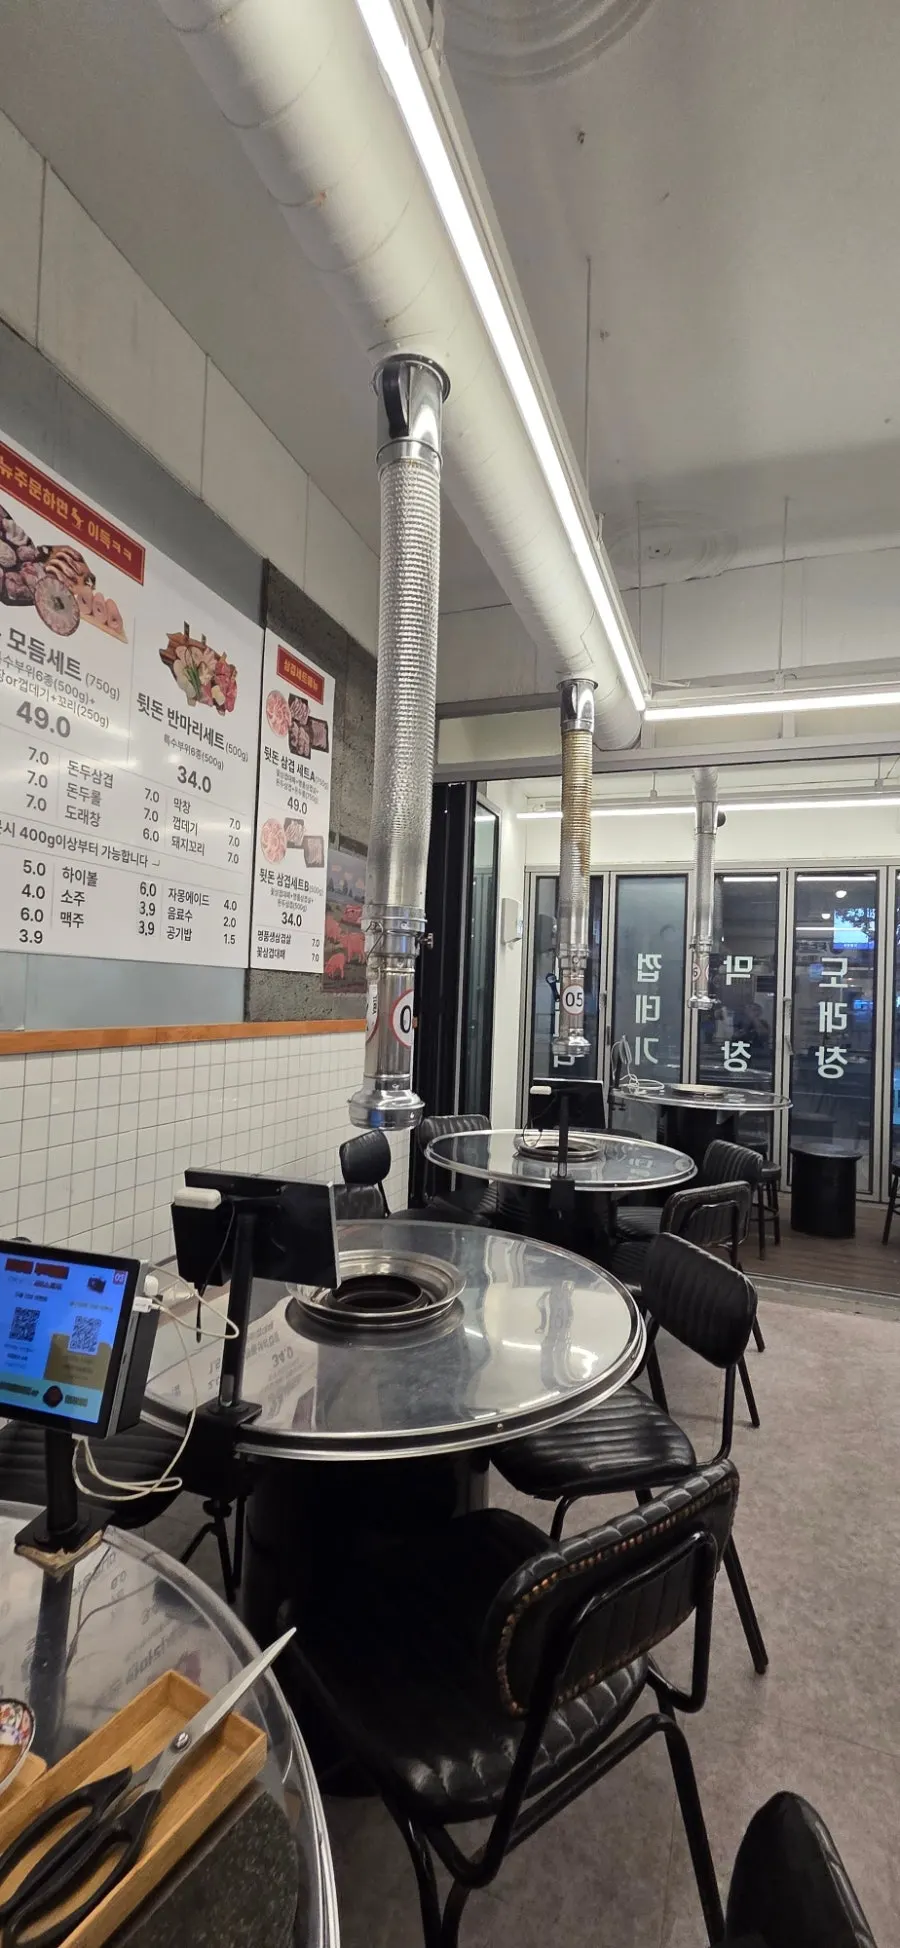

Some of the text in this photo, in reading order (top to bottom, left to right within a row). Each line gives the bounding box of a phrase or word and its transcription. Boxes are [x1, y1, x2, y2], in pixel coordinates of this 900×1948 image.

[7, 627, 120, 701] 모듬세트 (750g)
[16, 701, 71, 738] 49.0
[136, 692, 249, 763] 뒷돈 반마리세트 (500g)
[28, 746, 49, 765] 7.0
[263, 745, 280, 766] 뒷돈
[281, 755, 295, 774] 삼겹
[296, 763, 316, 783] 세트A
[27, 770, 48, 789] 7.0
[67, 760, 160, 803] 돈두삼겹 7.0
[177, 765, 211, 793] 34.0
[25, 793, 47, 812] 7.0
[173, 797, 241, 830] 막창 7.0
[287, 796, 307, 815] 49.0
[65, 805, 160, 842] 도래창 6.0
[143, 807, 159, 822] 7.0
[172, 816, 240, 847] 껍데기 7.0
[20, 827, 98, 857] 400g이상부터
[101, 845, 148, 867] 가능합니다
[171, 835, 239, 864] 돼지꼬리 7.0
[23, 859, 46, 876] 5.0
[61, 866, 157, 897] 하이볼 6.0
[259, 868, 275, 885] 뒷돈
[277, 872, 310, 892] 삼겹세트B
[21, 884, 45, 900] 4.0
[60, 889, 156, 916] 소주 3.9
[168, 888, 238, 911] 자몽에이드 4.0
[20, 907, 44, 923] 6.0
[60, 911, 155, 936] 맥주 3.9
[166, 906, 237, 928] 음료수 2.0
[281, 911, 302, 928] 34.0
[19, 929, 43, 944] 3.9
[166, 926, 236, 945] 공기밥 1.5
[311, 938, 320, 948] 7.0
[311, 952, 320, 962] 7.0
[565, 991, 583, 1007] 05
[400, 1004, 412, 1034] 0
